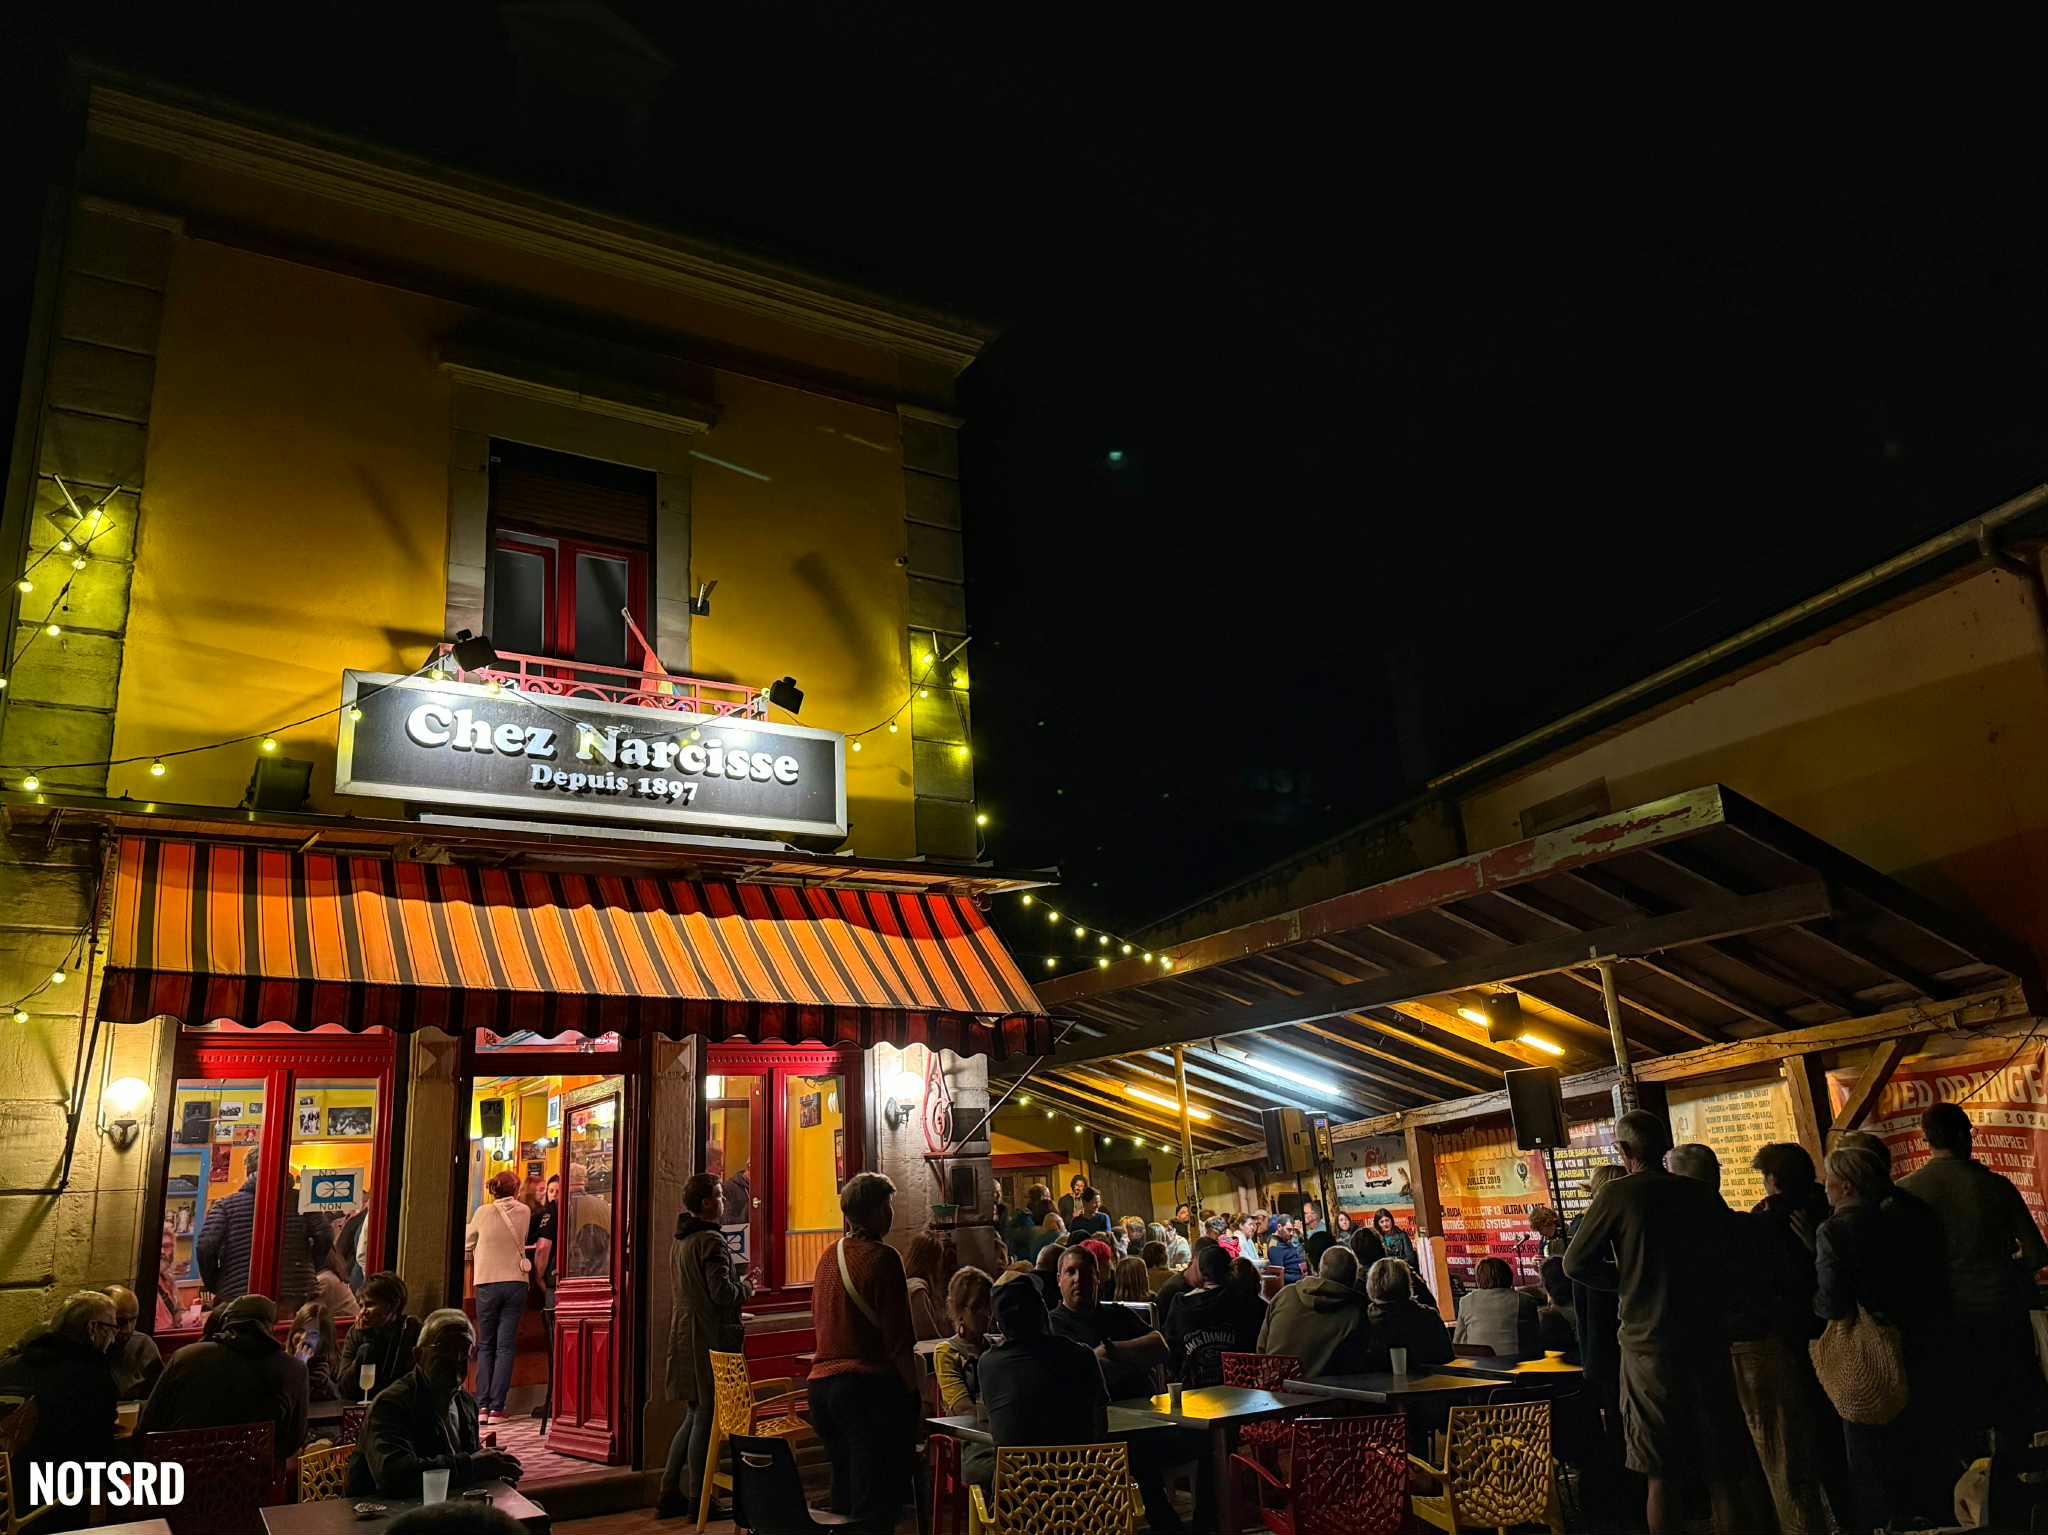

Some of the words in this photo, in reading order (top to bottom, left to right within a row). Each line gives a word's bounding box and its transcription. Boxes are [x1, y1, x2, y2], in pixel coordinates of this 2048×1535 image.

[406, 703, 556, 757] Chez
[576, 722, 800, 783] Narcisse
[530, 763, 629, 790] Depuis
[638, 777, 698, 800] 1897
[1935, 1063, 2048, 1105] ORANGE
[319, 1202, 343, 1213] NON
[1486, 1217, 1512, 1230] SYSTEM
